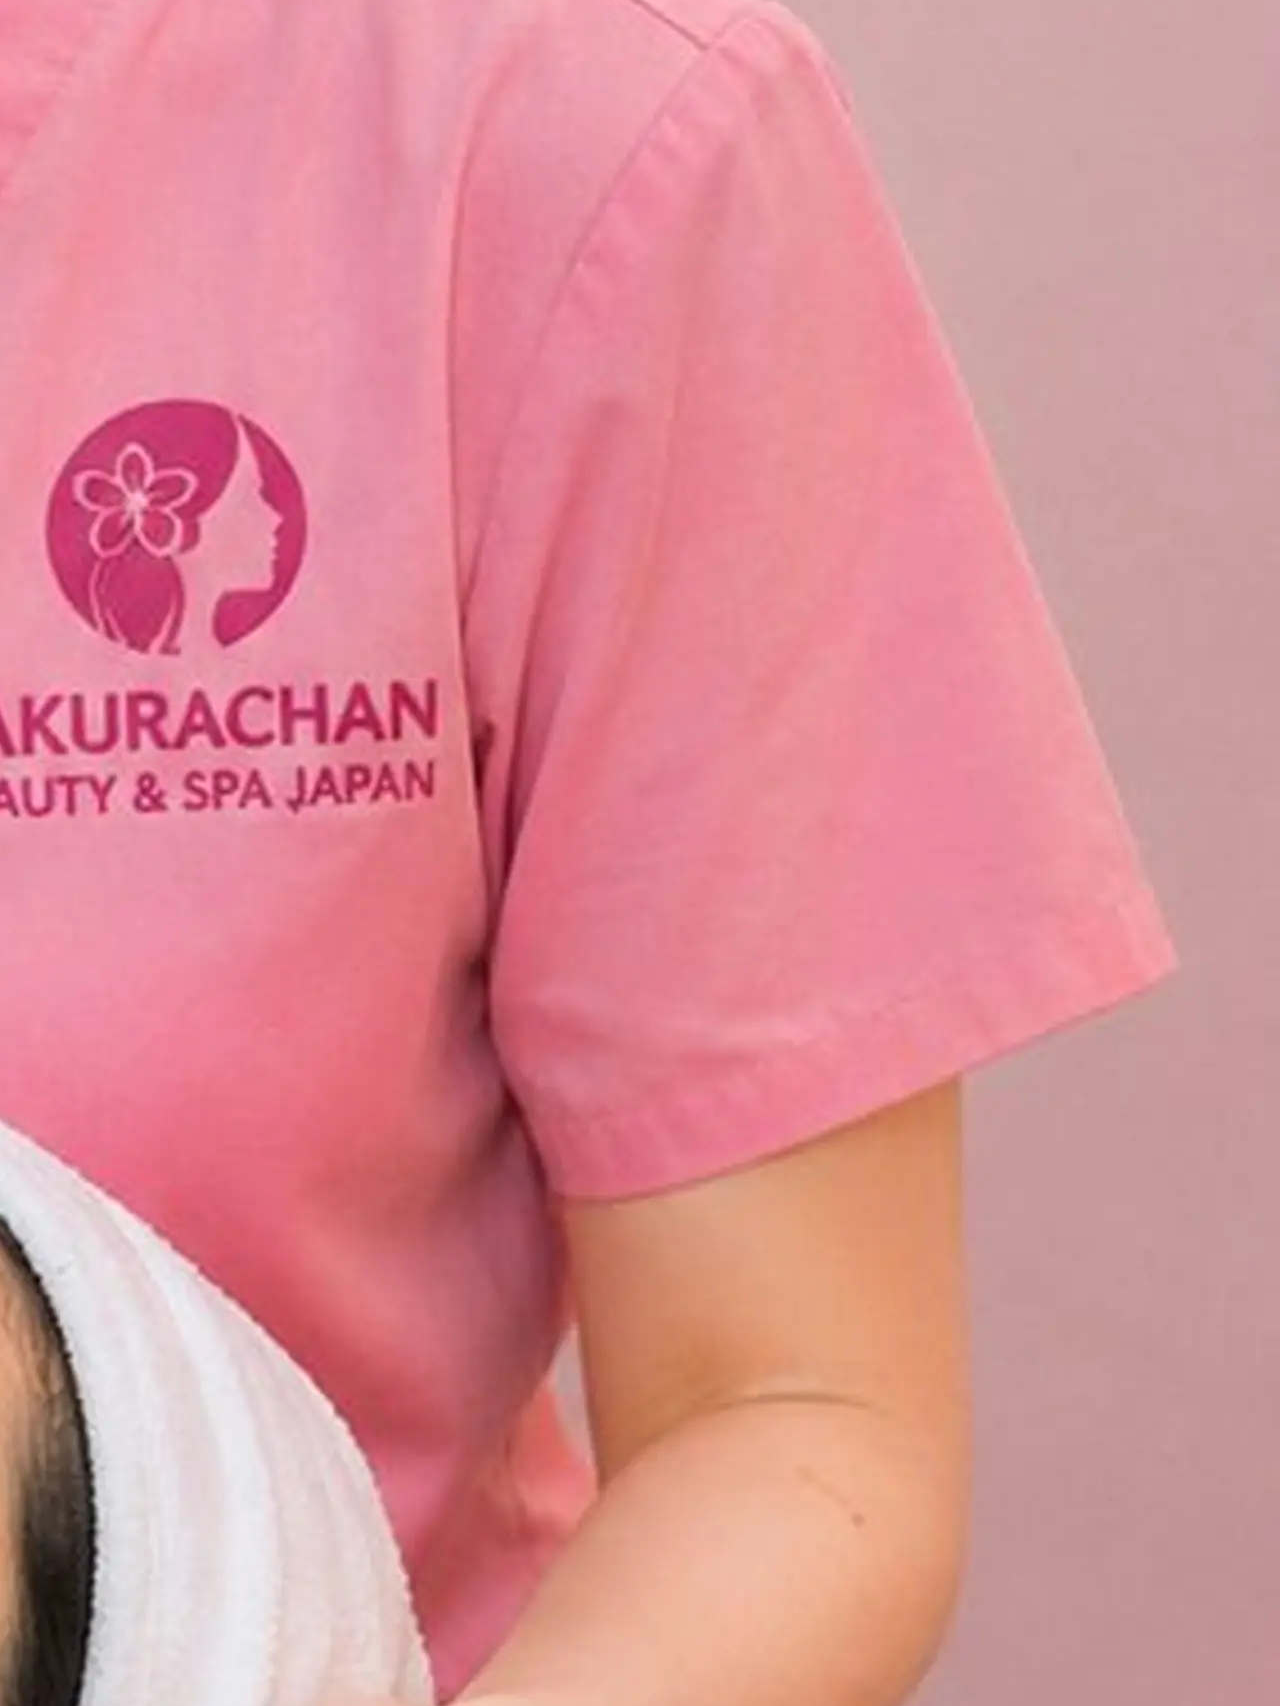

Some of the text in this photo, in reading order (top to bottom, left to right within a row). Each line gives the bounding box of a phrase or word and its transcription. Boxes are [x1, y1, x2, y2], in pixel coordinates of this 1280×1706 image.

[132, 769, 169, 814] &
[182, 768, 274, 812] SPA
[287, 760, 436, 814] JAPAN
